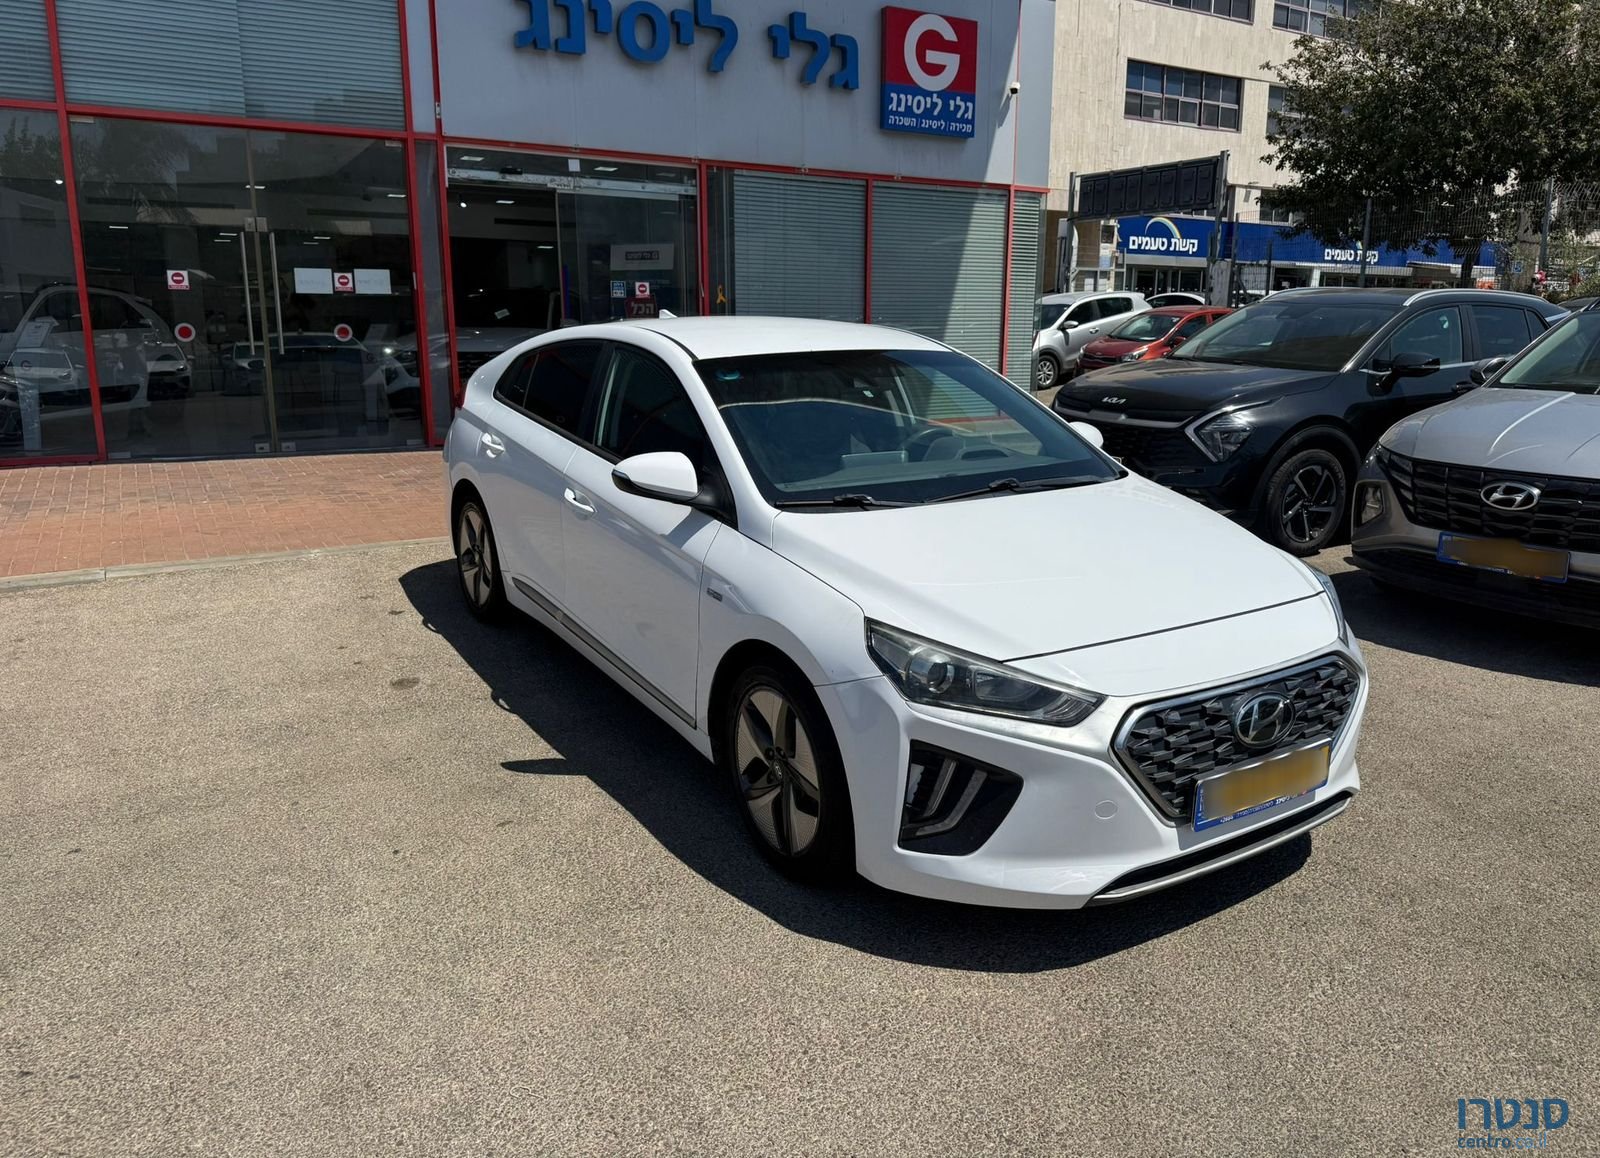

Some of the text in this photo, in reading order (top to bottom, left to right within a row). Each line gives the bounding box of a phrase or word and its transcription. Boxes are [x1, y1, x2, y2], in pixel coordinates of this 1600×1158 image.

[514, 0, 859, 90] גלי ליסינג
[904, 13, 960, 91] G
[888, 92, 973, 119] גלי ליסינג
[888, 115, 916, 127] השכרה
[949, 122, 972, 133] מכירה
[1129, 236, 1198, 255] קשת טעמים
[1324, 248, 1354, 261] טעמים
